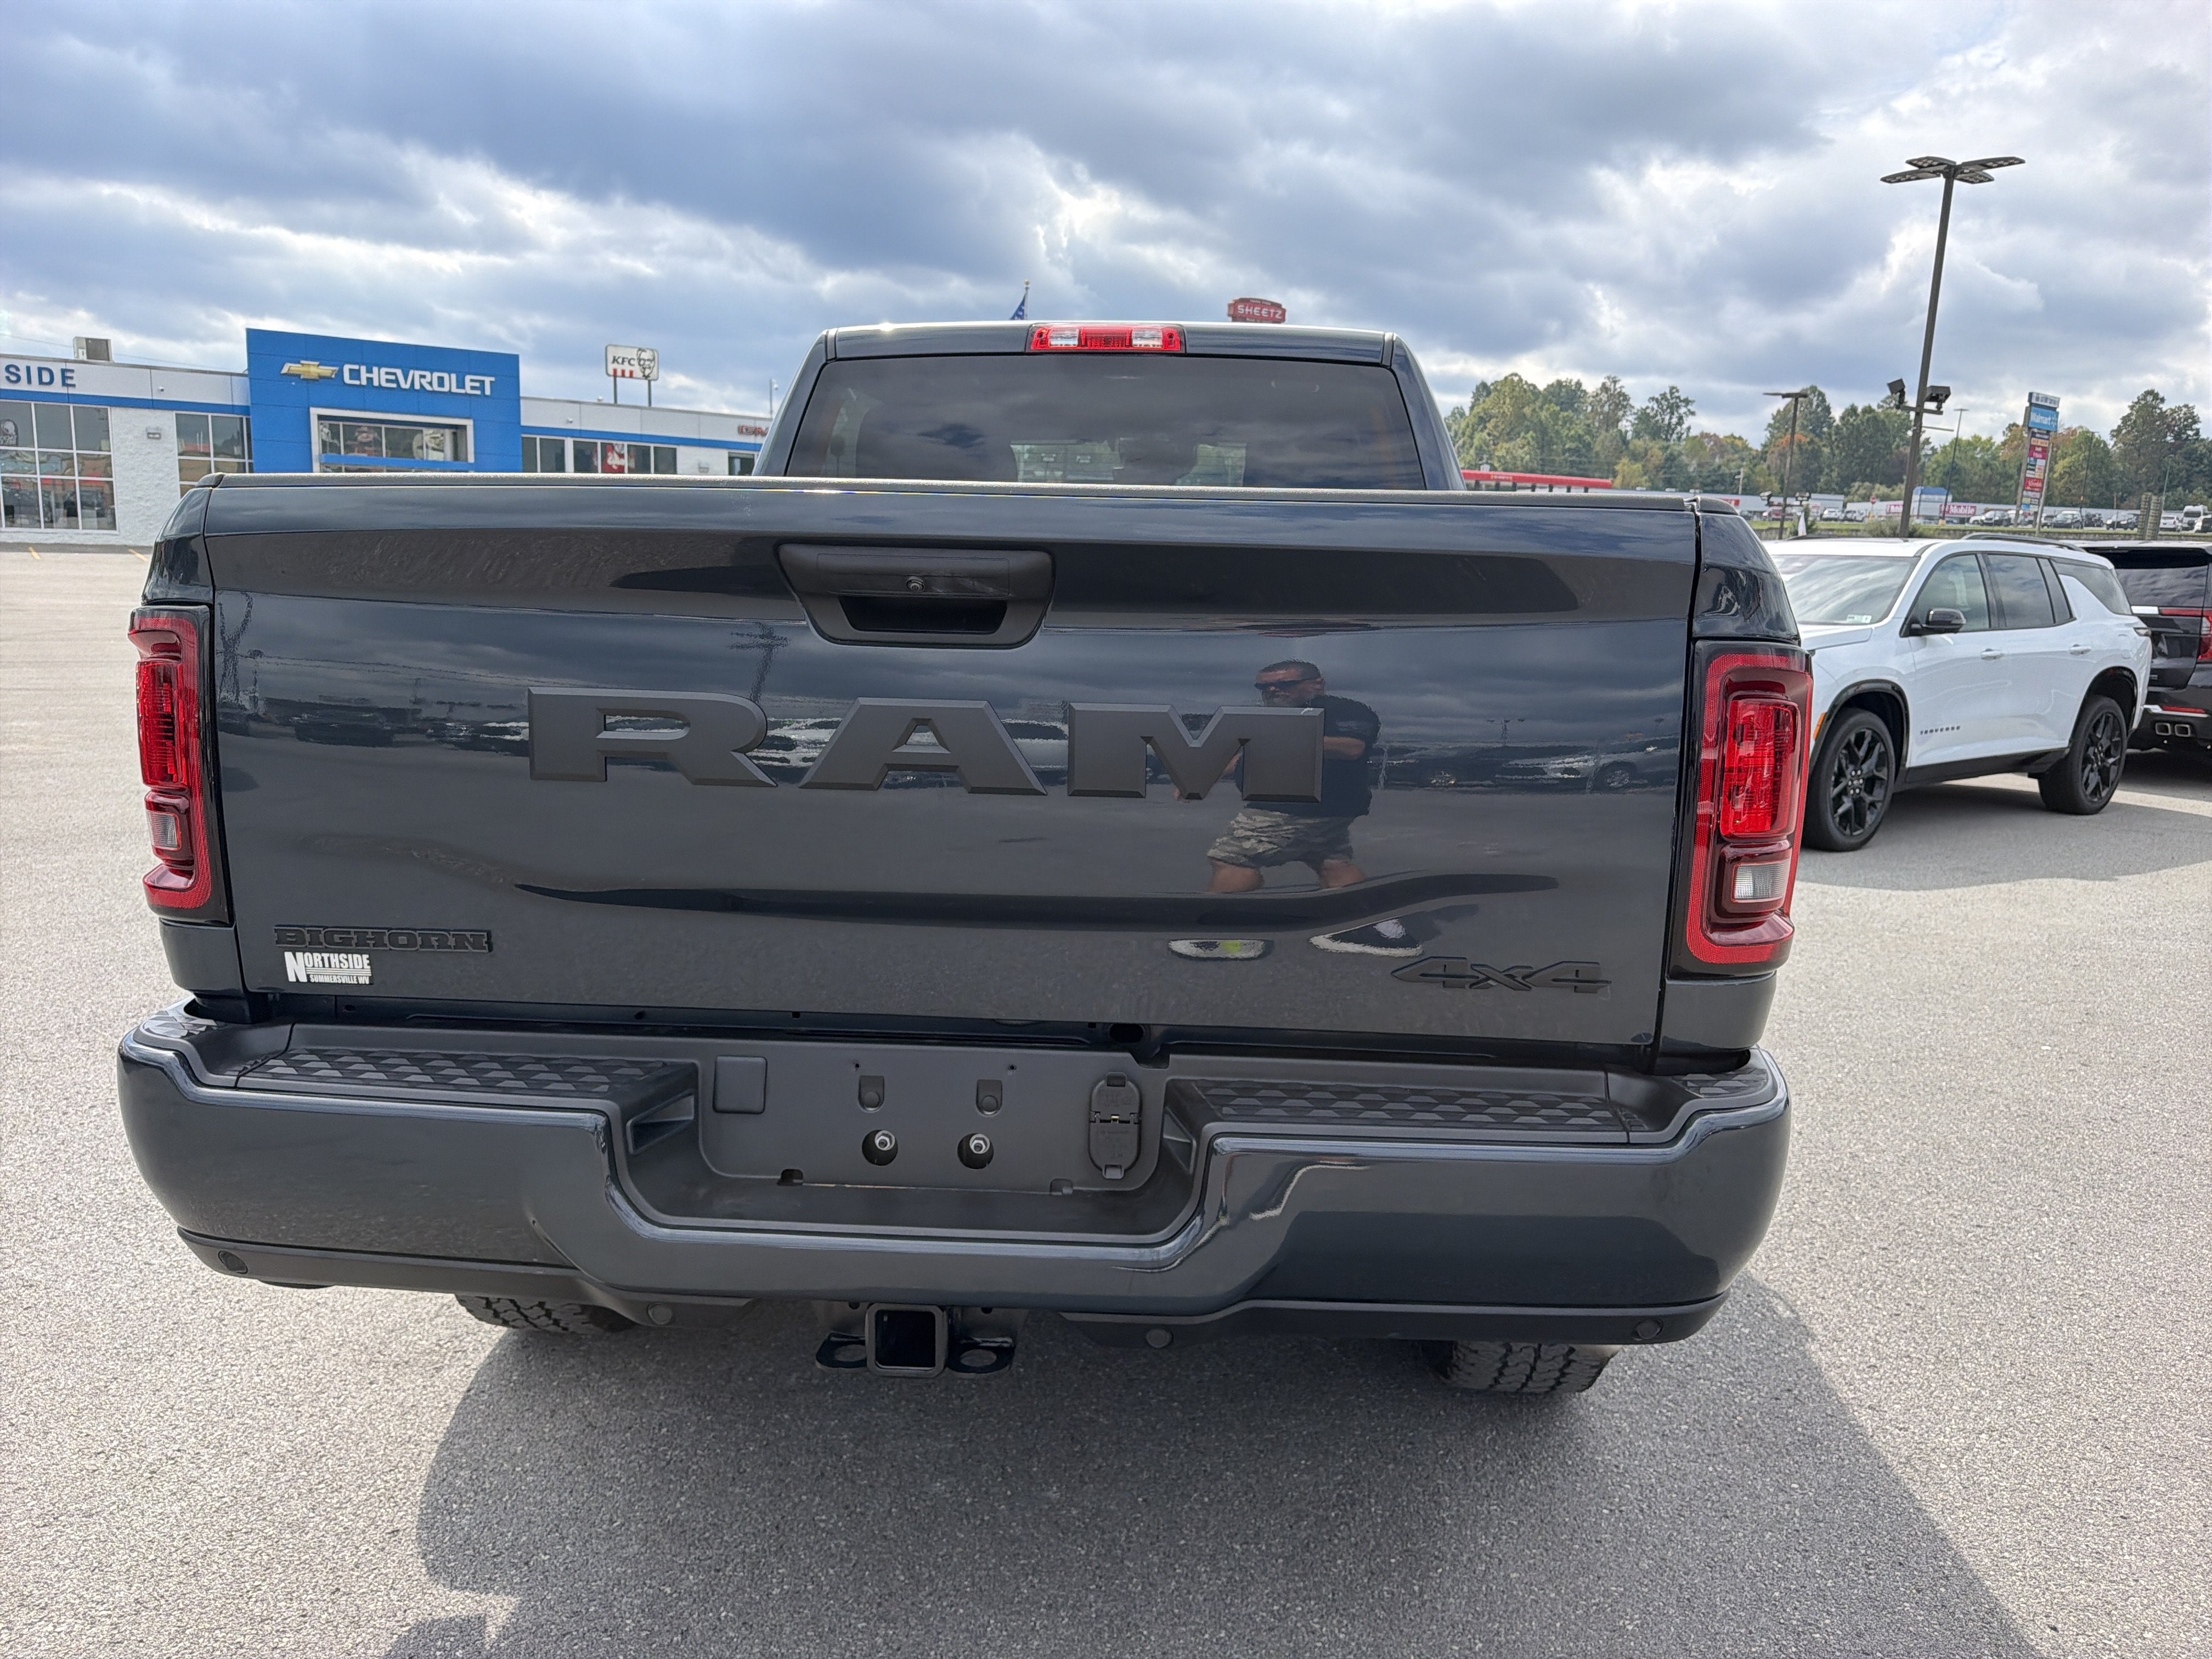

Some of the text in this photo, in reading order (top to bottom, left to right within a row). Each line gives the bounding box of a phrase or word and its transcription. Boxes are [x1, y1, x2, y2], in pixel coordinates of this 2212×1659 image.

[1237, 304, 1282, 318] SHEETZ
[612, 355, 635, 366] KFC
[4, 364, 76, 387] SIDE
[343, 364, 495, 396] CHEVROLET
[2030, 411, 2051, 425] Walmart
[738, 425, 769, 437] GM
[528, 686, 1325, 803] RAM
[274, 924, 492, 953] BIGHORN
[284, 951, 371, 983] NORTHSIDE
[309, 974, 370, 985] SUMMERSVILLE WV
